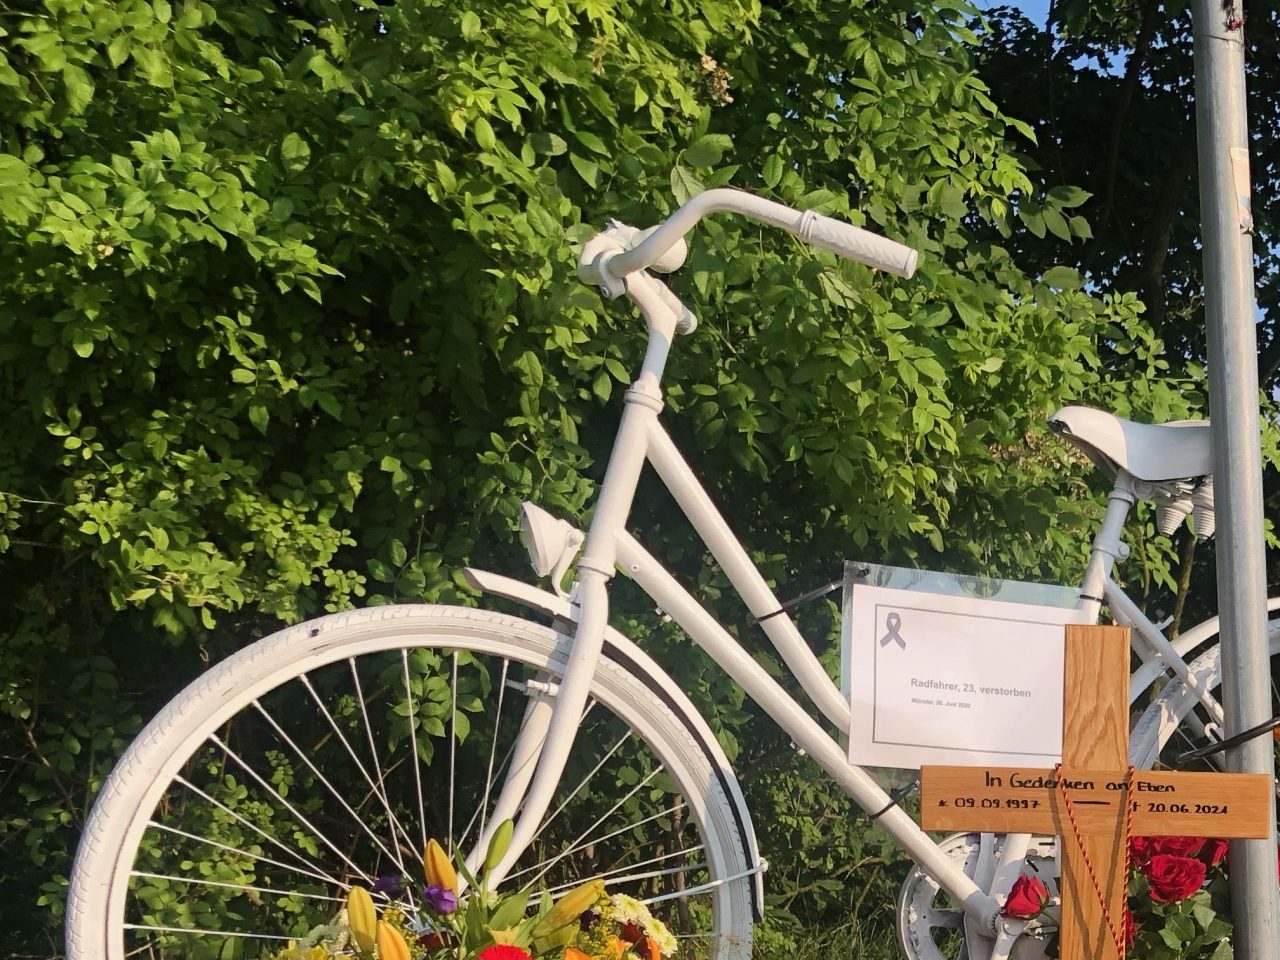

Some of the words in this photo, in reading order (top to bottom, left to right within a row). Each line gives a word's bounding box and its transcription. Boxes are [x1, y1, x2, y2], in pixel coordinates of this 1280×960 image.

[910, 677, 961, 693] Radfahrer,
[963, 683, 977, 694] 23,
[979, 686, 1032, 698] verstorben
[985, 771, 1002, 788] In
[1106, 781, 1129, 791] an
